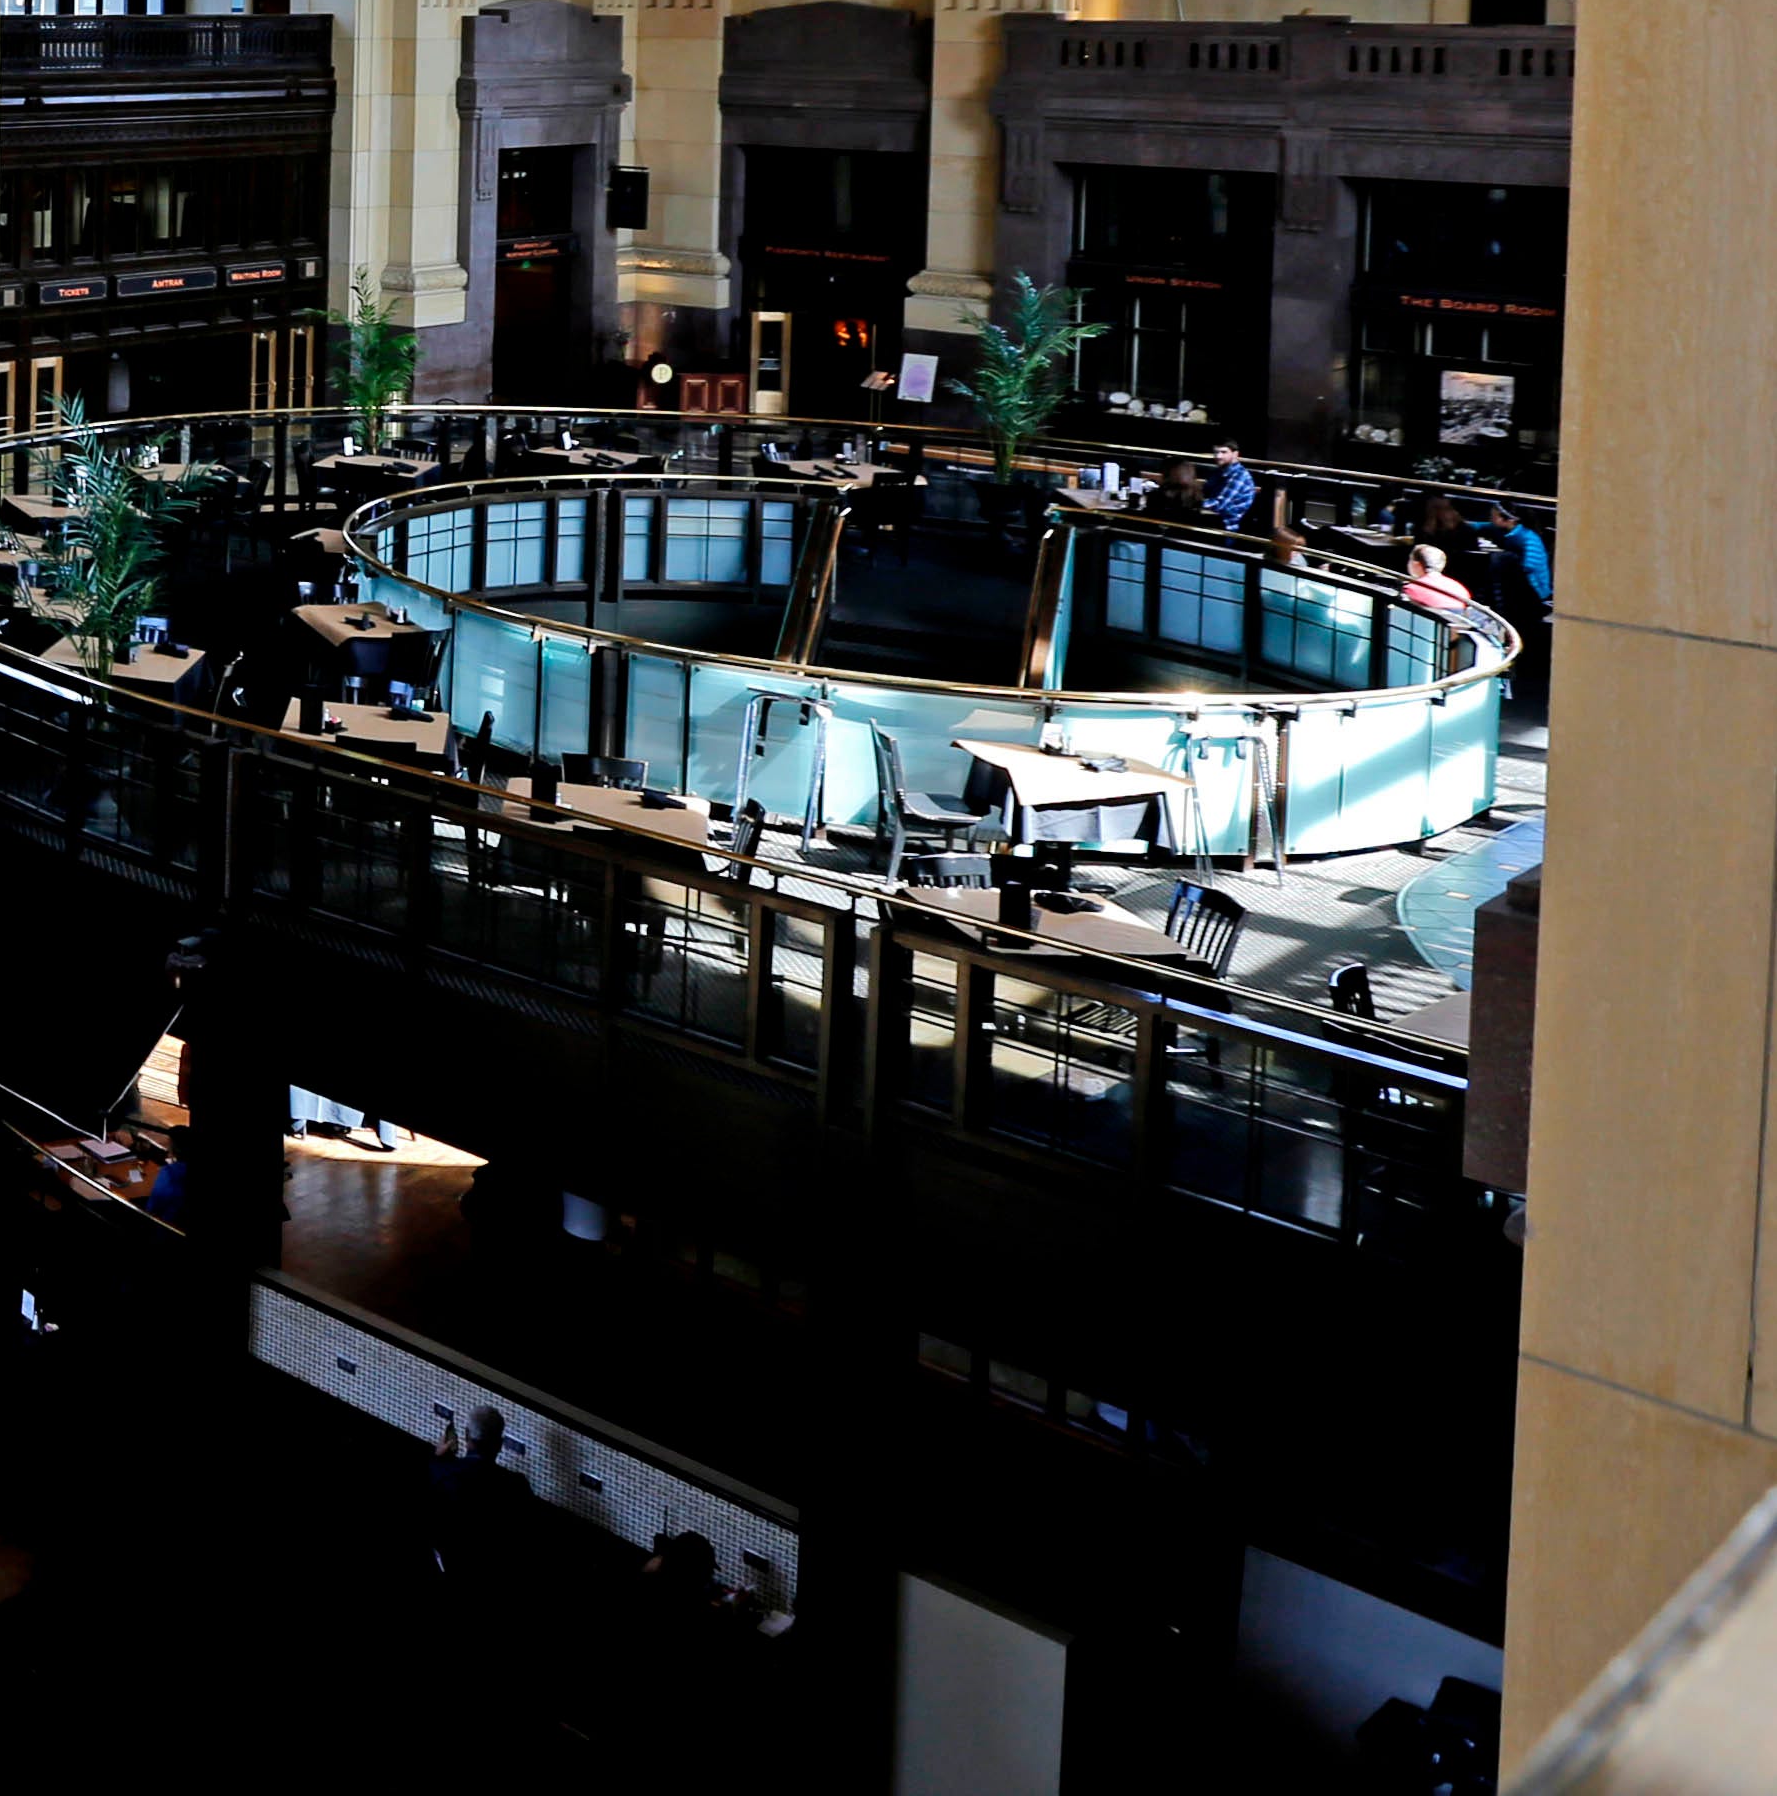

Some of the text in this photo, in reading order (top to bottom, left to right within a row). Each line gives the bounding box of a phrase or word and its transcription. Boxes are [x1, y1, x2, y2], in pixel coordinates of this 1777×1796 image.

[262, 269, 282, 278] ROOM
[151, 278, 185, 290] AMTRAK
[58, 286, 90, 298] TICKETS
[1399, 295, 1557, 316] THE BOARD ROOM
